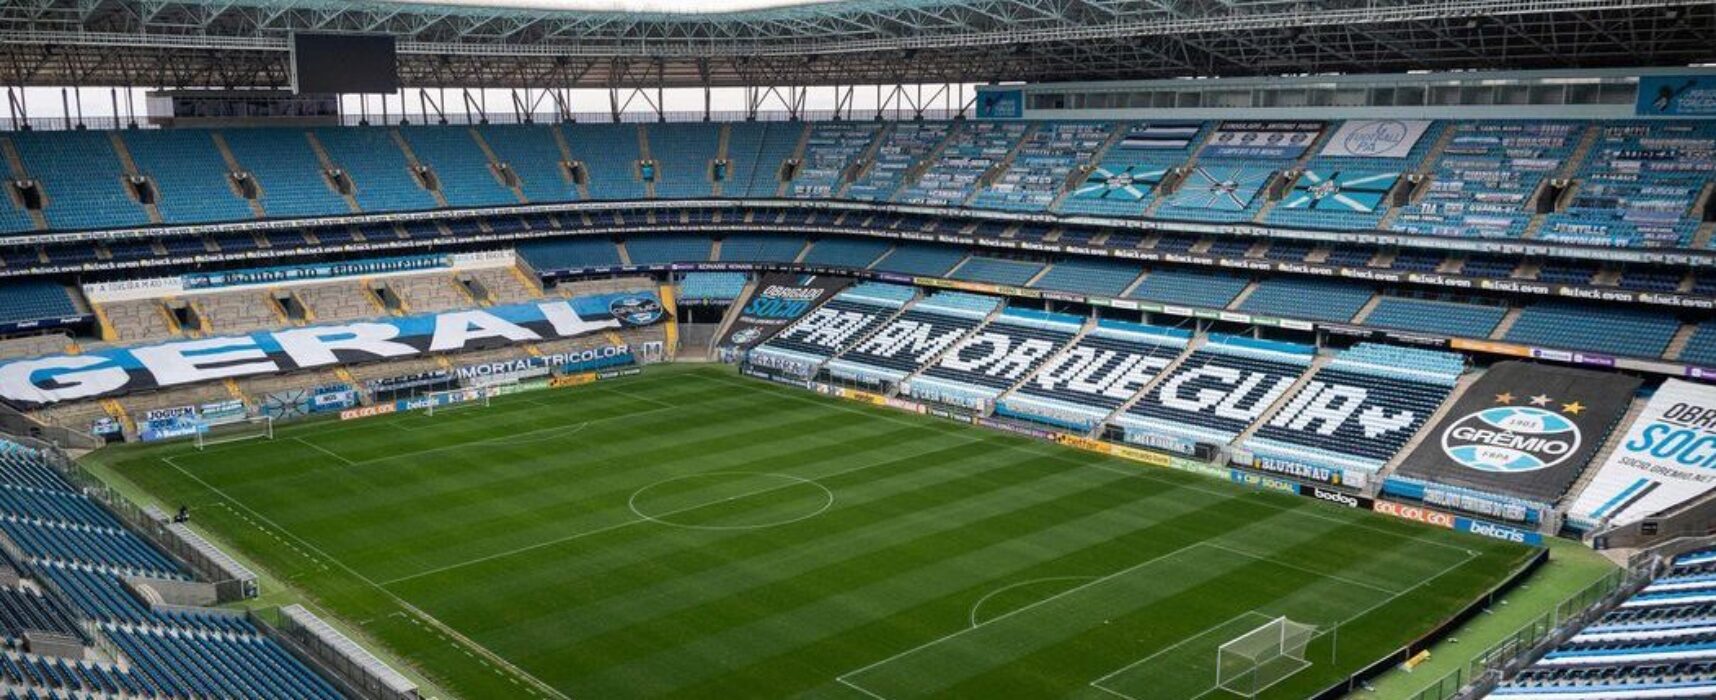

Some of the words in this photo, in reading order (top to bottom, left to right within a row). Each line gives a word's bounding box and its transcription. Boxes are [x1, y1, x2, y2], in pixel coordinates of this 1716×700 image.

[763, 284, 825, 301] OBRIGADO
[0, 301, 621, 404] GERAL
[456, 358, 537, 380] IMORTAL
[541, 345, 629, 367] TRICOLOR
[1036, 345, 1175, 399] QUE
[1160, 364, 1369, 437] GUIA
[1452, 426, 1569, 455] GRÊMIO
[1261, 458, 1330, 481] BLUMENAU
[1314, 488, 1358, 508] bodog
[1374, 501, 1396, 514] GOL
[1400, 506, 1424, 521] GOL
[1427, 512, 1454, 528] GOL
[1469, 520, 1525, 543] betcris
